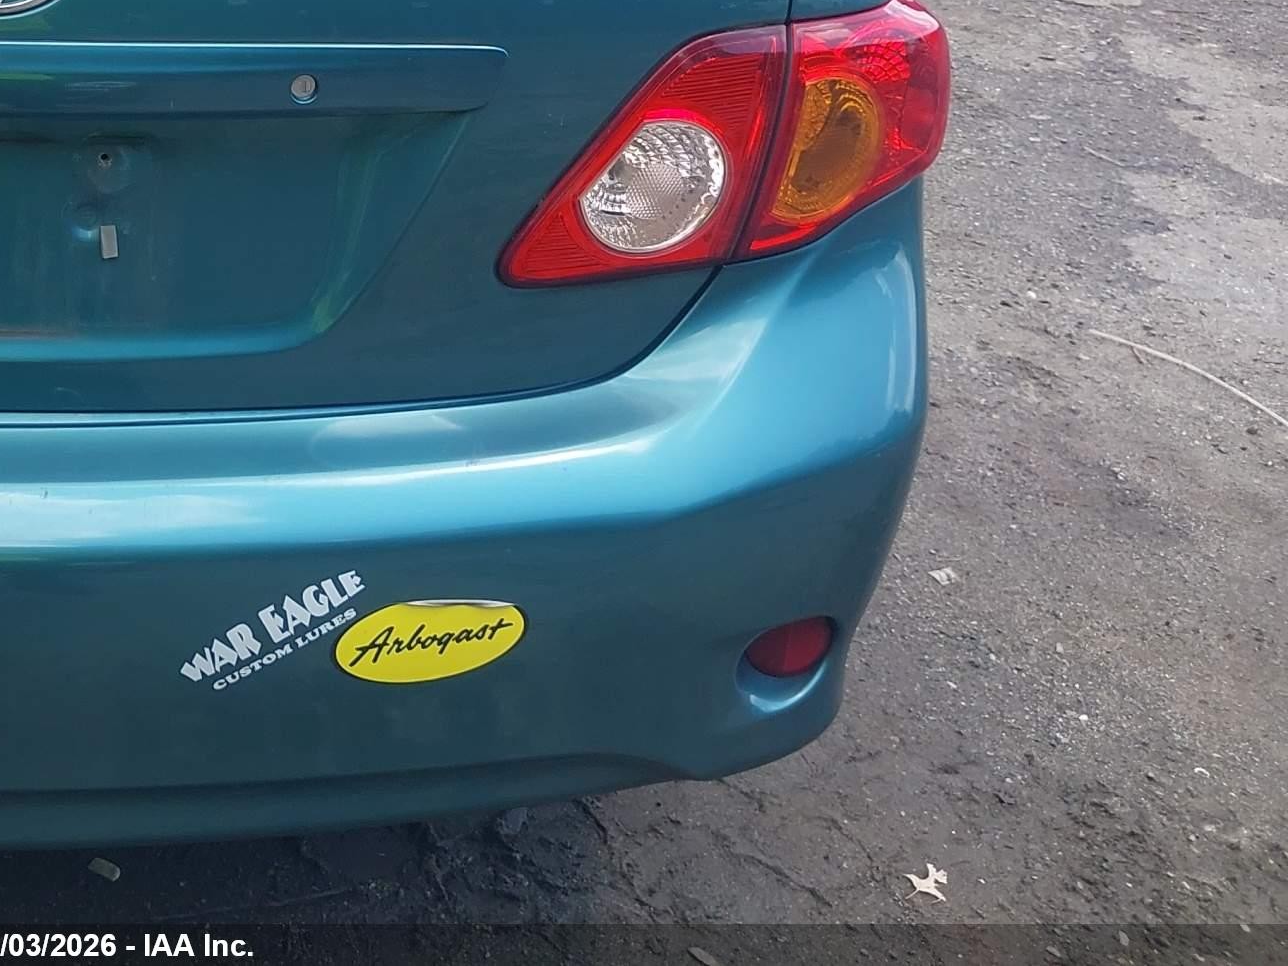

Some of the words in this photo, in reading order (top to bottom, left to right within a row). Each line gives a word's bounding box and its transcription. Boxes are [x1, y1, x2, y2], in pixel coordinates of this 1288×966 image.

[180, 622, 262, 682] WAR
[258, 570, 365, 644] EAGLE
[212, 643, 293, 690] CUSTOM
[296, 608, 358, 652] LURES
[348, 618, 515, 668] Arbogast
